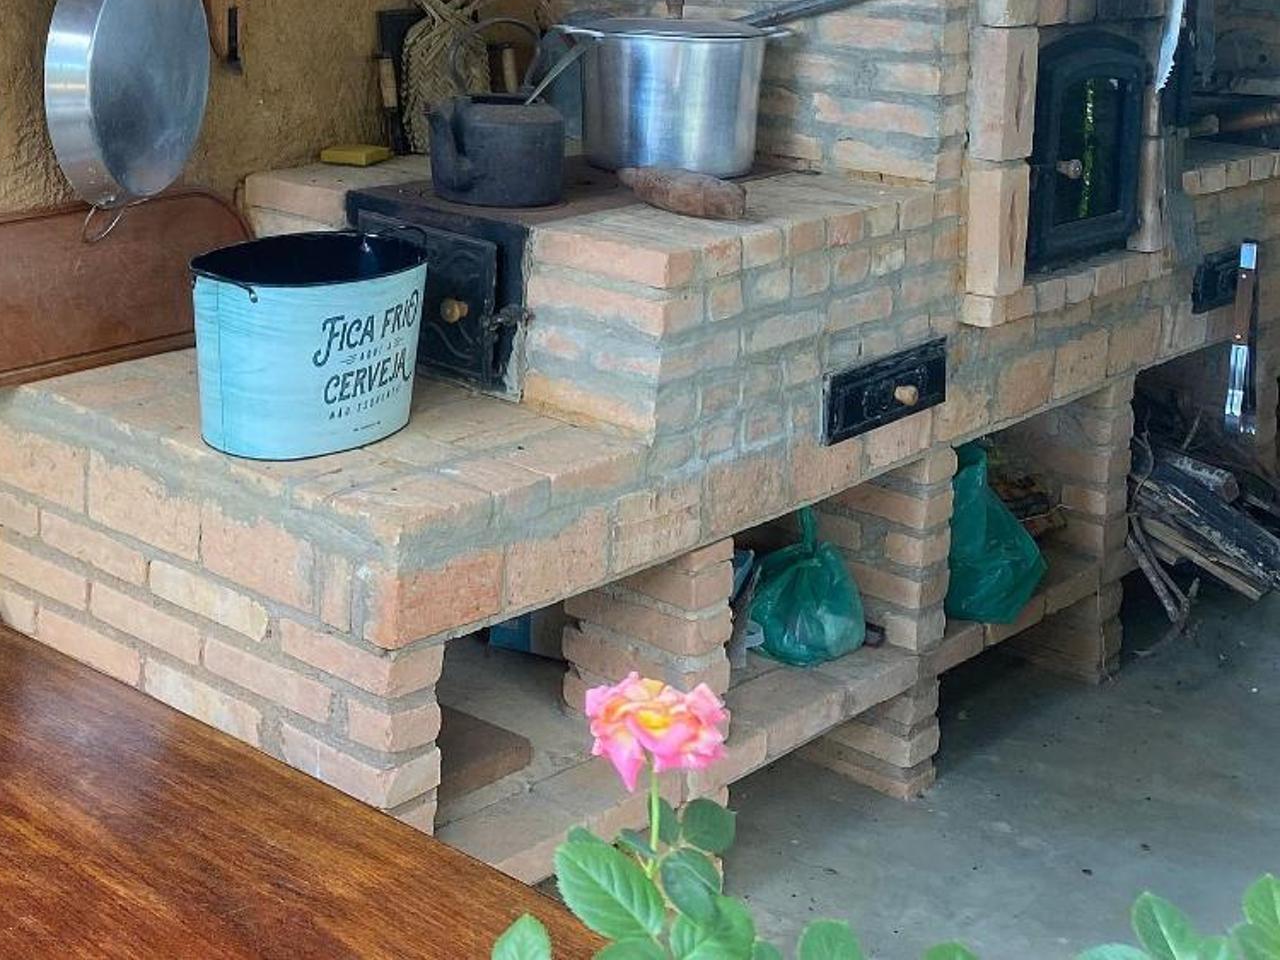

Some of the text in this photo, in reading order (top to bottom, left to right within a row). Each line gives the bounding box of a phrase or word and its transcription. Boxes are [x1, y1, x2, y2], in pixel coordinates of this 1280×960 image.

[312, 289, 419, 368] FICA FRIO
[324, 347, 412, 405] CERVEJA
